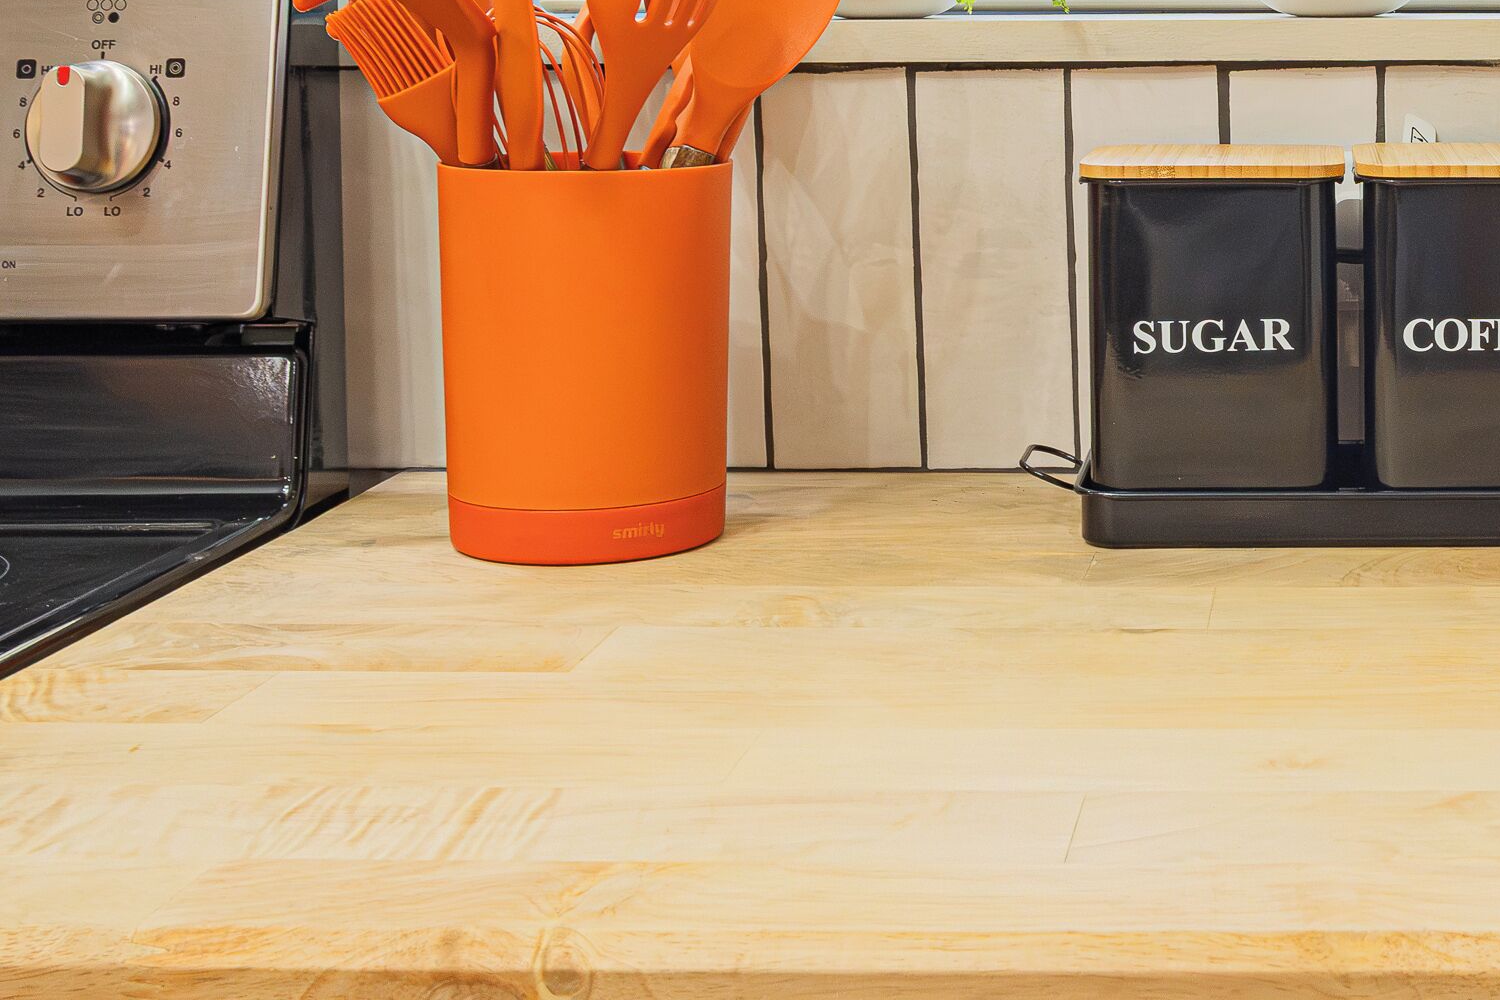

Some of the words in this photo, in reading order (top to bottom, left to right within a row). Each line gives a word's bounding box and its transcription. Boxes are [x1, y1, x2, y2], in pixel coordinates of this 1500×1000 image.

[91, 40, 117, 50] OFF
[150, 64, 162, 75] HI
[20, 97, 27, 108] 8
[173, 96, 180, 107] 8
[13, 128, 21, 139] 6
[175, 128, 183, 138] 6
[17, 161, 26, 170] 4
[163, 160, 171, 170] 4
[37, 188, 45, 198] 2
[143, 187, 150, 197] 2
[66, 206, 84, 217] LO
[103, 206, 121, 217] LO
[1132, 318, 1295, 355] SUGAR
[612, 521, 665, 540] smirly
